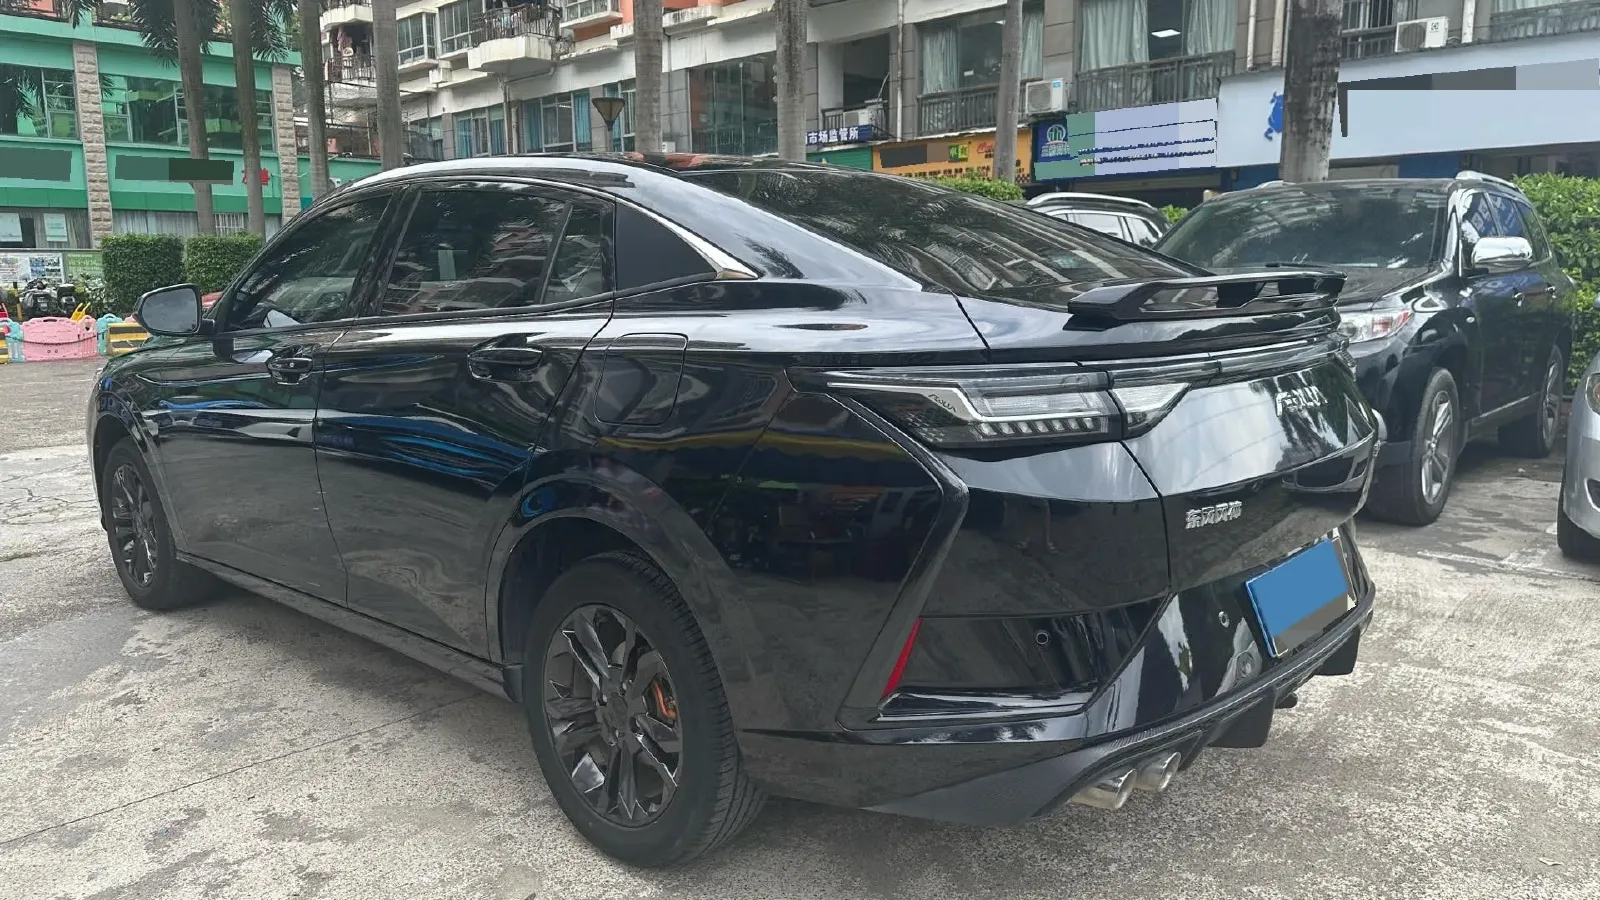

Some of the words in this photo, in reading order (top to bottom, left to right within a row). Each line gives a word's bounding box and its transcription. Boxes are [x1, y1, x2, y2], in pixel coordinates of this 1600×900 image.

[805, 127, 859, 144] 市场监管所
